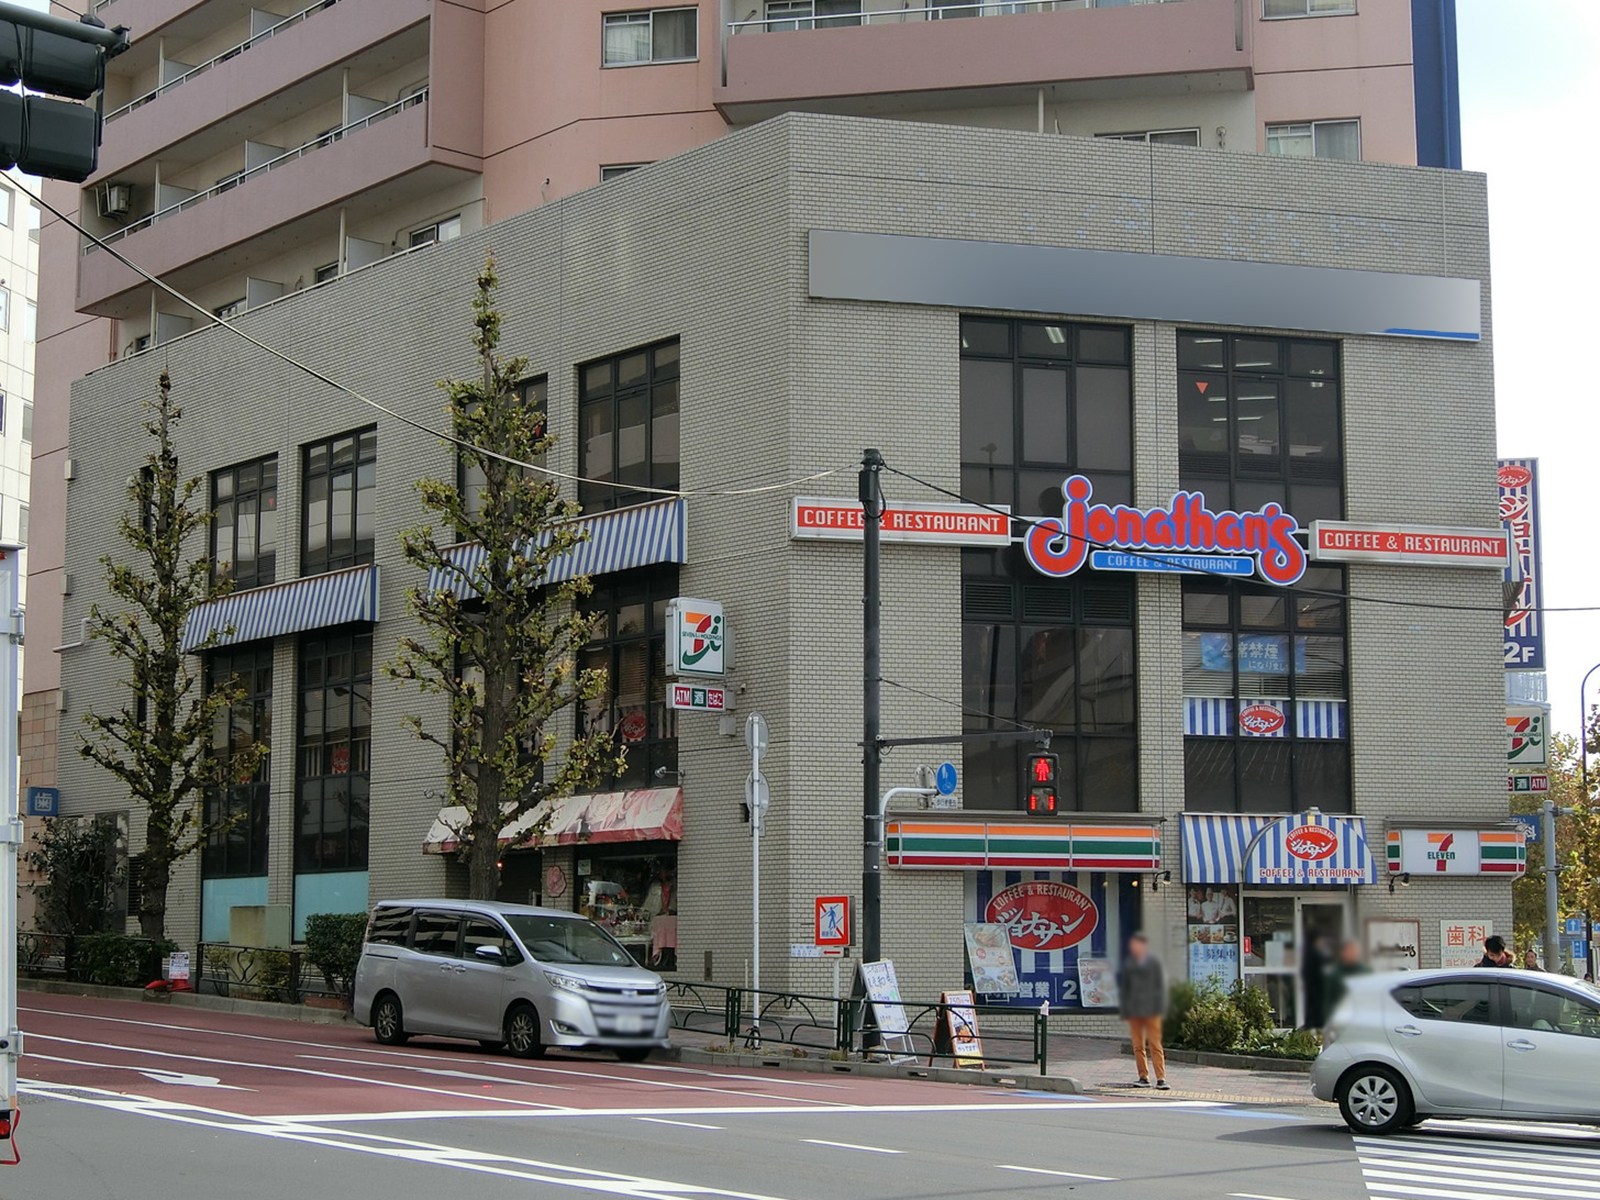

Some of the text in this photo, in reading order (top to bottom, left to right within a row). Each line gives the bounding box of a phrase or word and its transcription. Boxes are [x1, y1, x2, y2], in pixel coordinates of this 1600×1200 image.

[804, 509, 864, 527] COFFEE
[893, 513, 999, 532] RESTAURANT
[1325, 532, 1500, 555] COFFEE & RESTAURANT
[1107, 555, 1150, 568] COFFEE
[1166, 558, 1239, 571] RESTAURANT
[1220, 641, 1278, 660] 全席禁煙
[1505, 641, 1535, 664] 2F
[676, 689, 690, 704] ATM
[694, 690, 704, 705] 酒
[708, 692, 723, 706] たばこ
[1532, 777, 1547, 790] ATM
[34, 792, 53, 812] 歯
[1259, 867, 1366, 878] COFFEE & RESTAURANT
[993, 886, 1025, 911] COFFEE
[1037, 884, 1092, 912] RESTAURANT
[994, 907, 1087, 948] ジョナサン
[1446, 925, 1486, 947] 歯科
